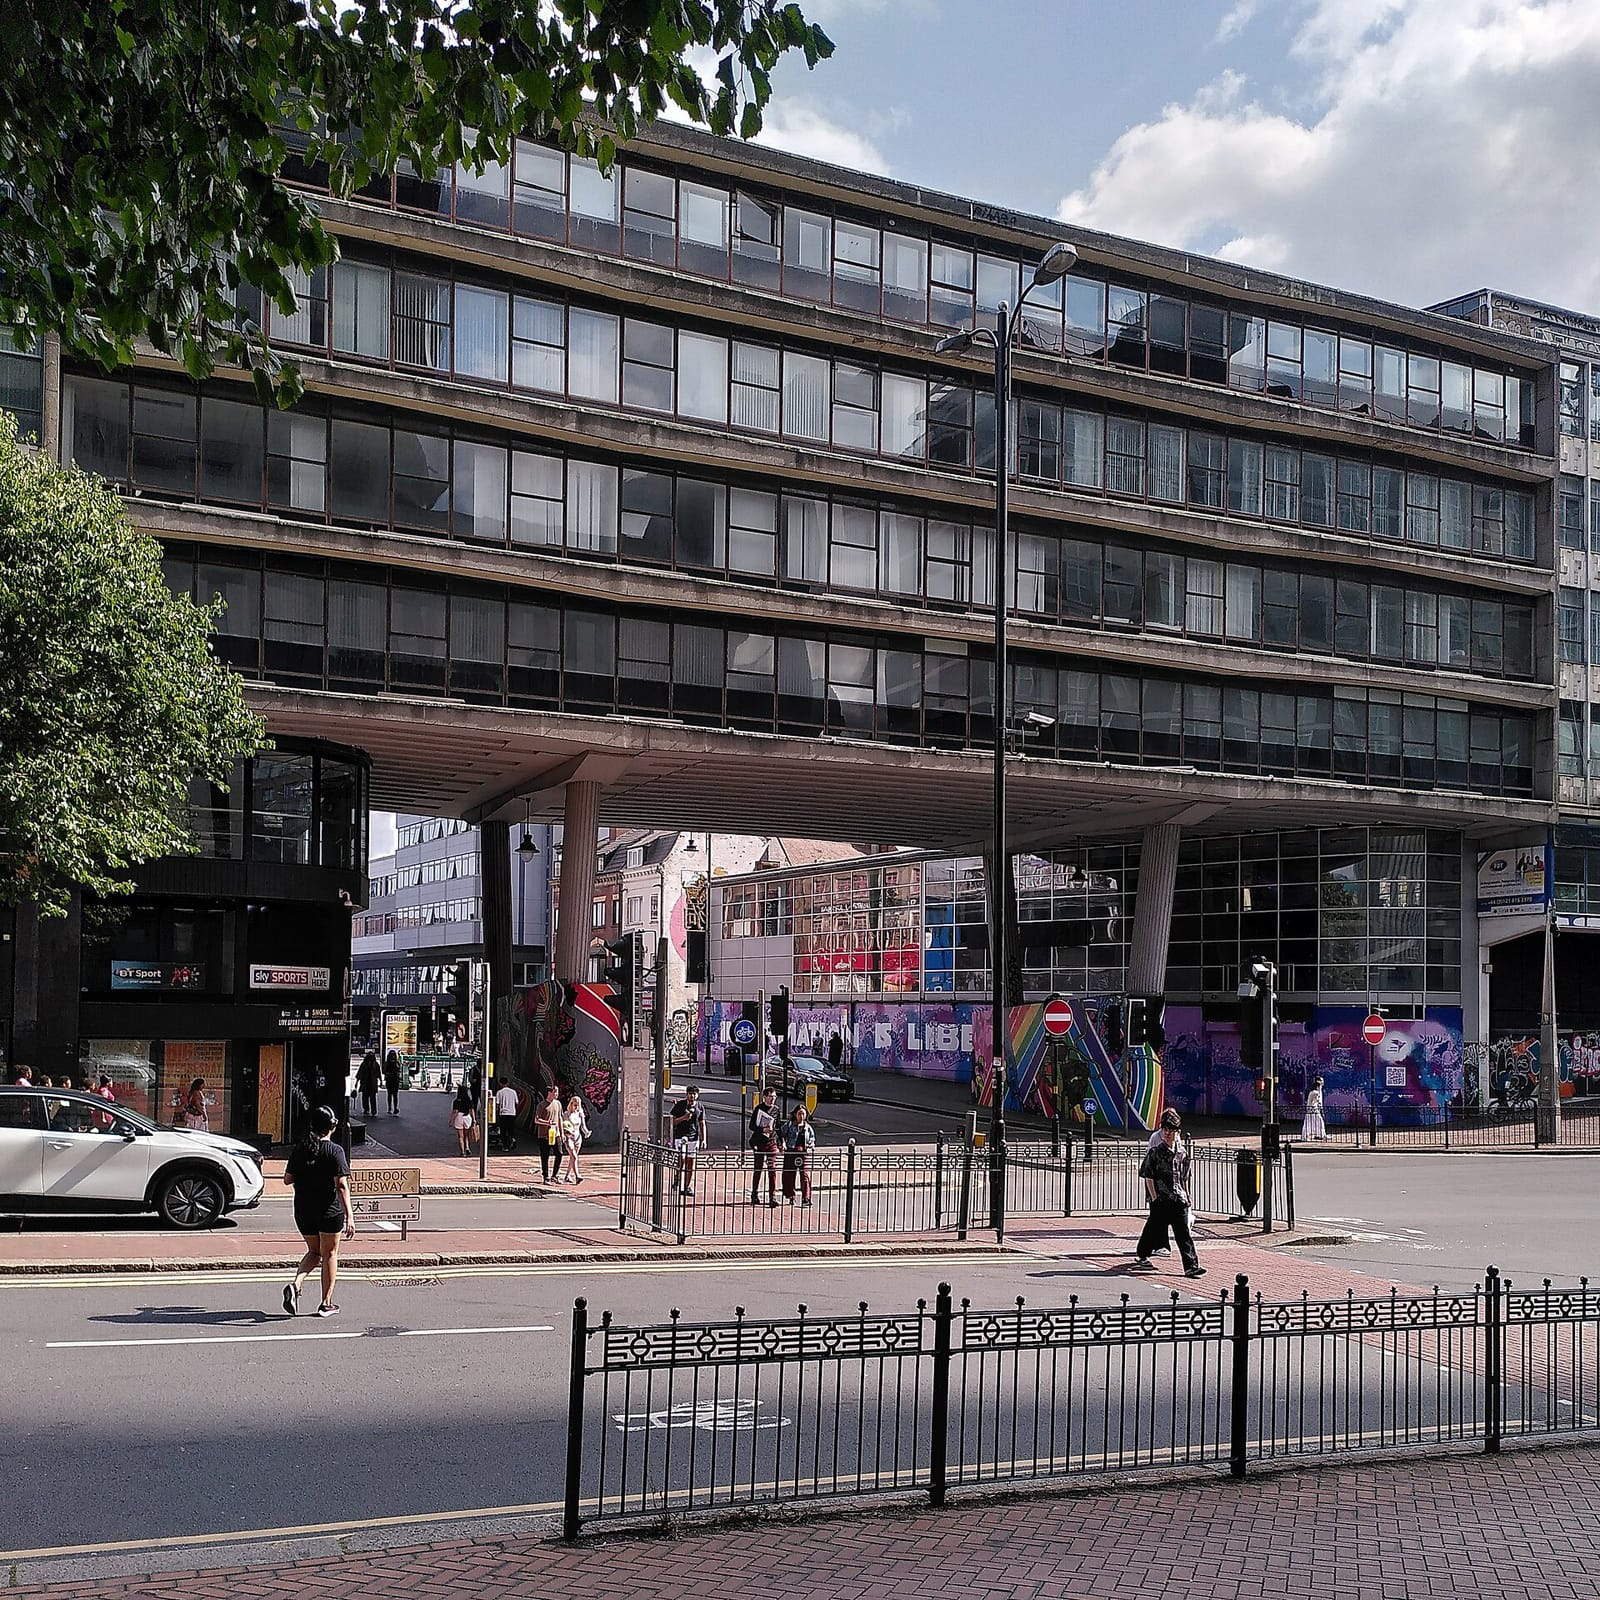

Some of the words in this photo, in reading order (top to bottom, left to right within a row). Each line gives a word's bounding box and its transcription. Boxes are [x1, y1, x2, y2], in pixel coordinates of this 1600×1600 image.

[135, 969, 161, 979] Sport
[255, 970, 270, 983] sky
[272, 971, 308, 984] SPORTS
[312, 970, 327, 979] LIVE
[312, 978, 328, 987] HERE
[875, 1022, 892, 1049] IS
[348, 1170, 408, 1182] ALLBROOK
[349, 1181, 404, 1192] EENSWAY
